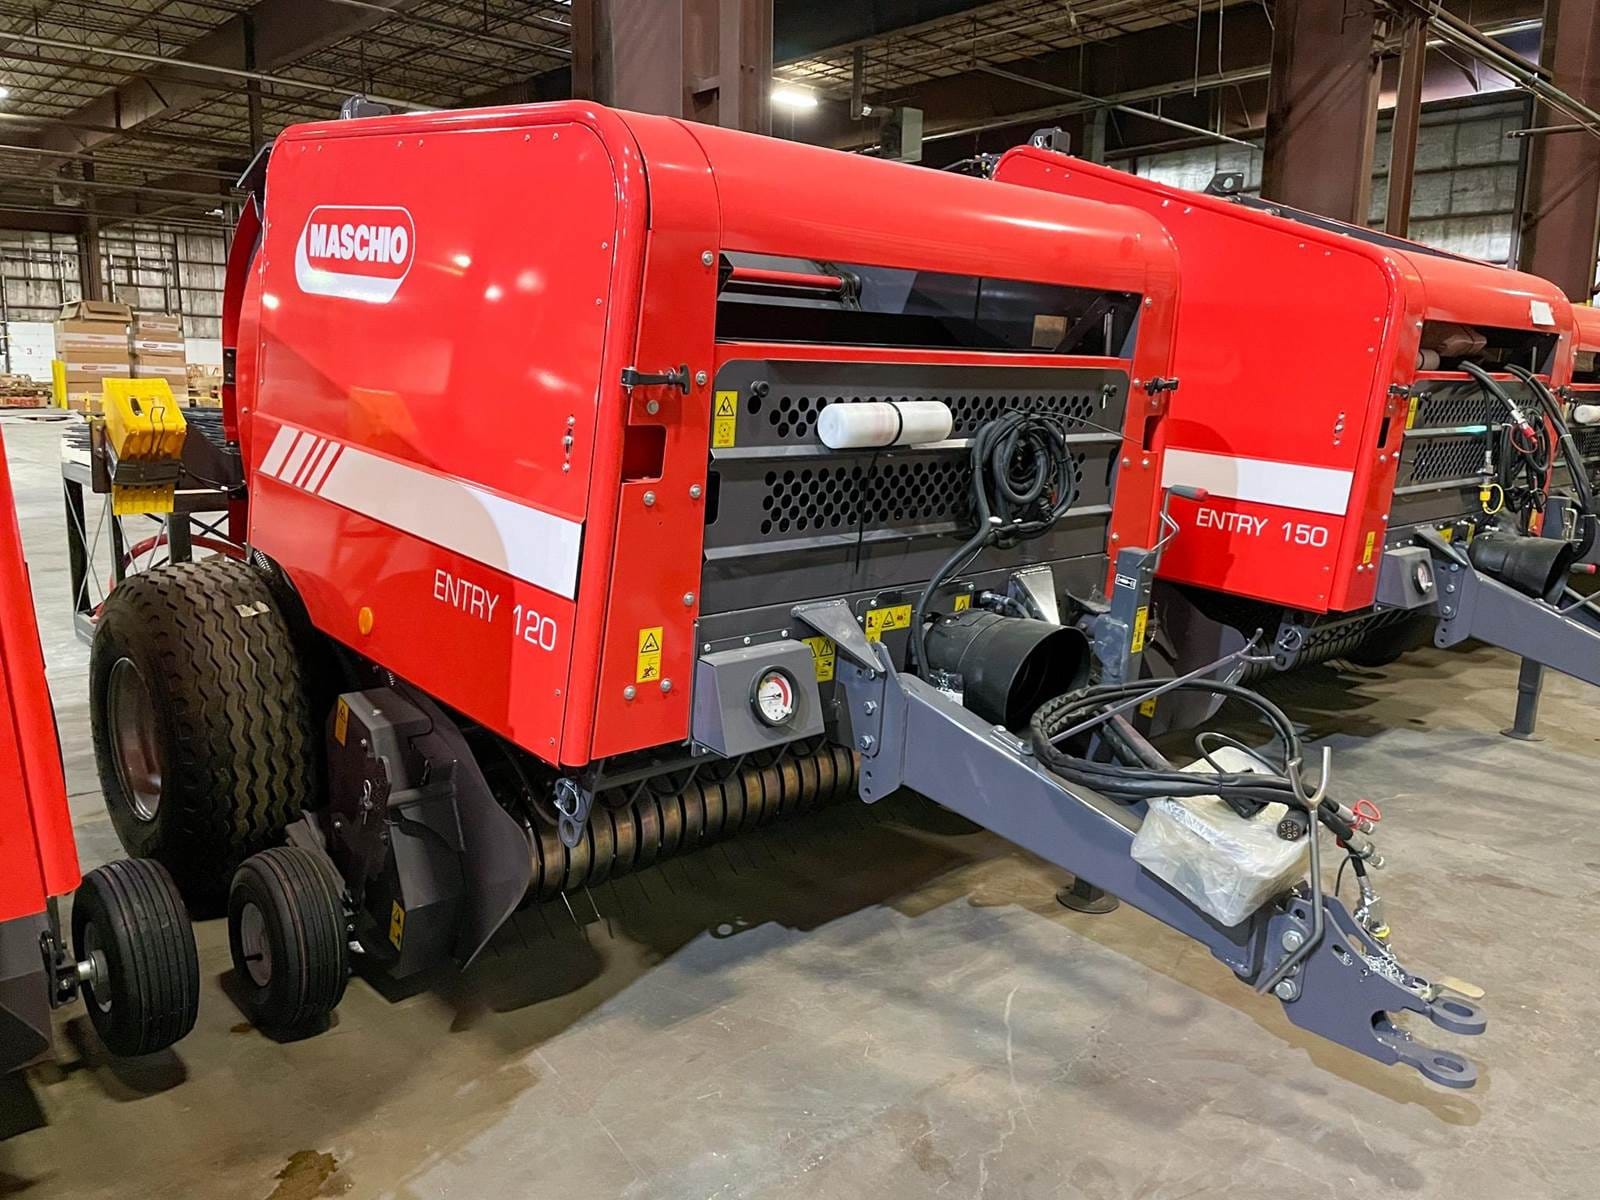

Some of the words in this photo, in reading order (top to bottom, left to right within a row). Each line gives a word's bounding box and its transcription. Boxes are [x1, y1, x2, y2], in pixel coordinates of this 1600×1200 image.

[309, 223, 408, 265] MASCHIO
[1196, 507, 1269, 537] ENTRY
[1281, 521, 1329, 547] 150
[433, 568, 499, 623] ENTRY
[512, 604, 557, 651] 120
